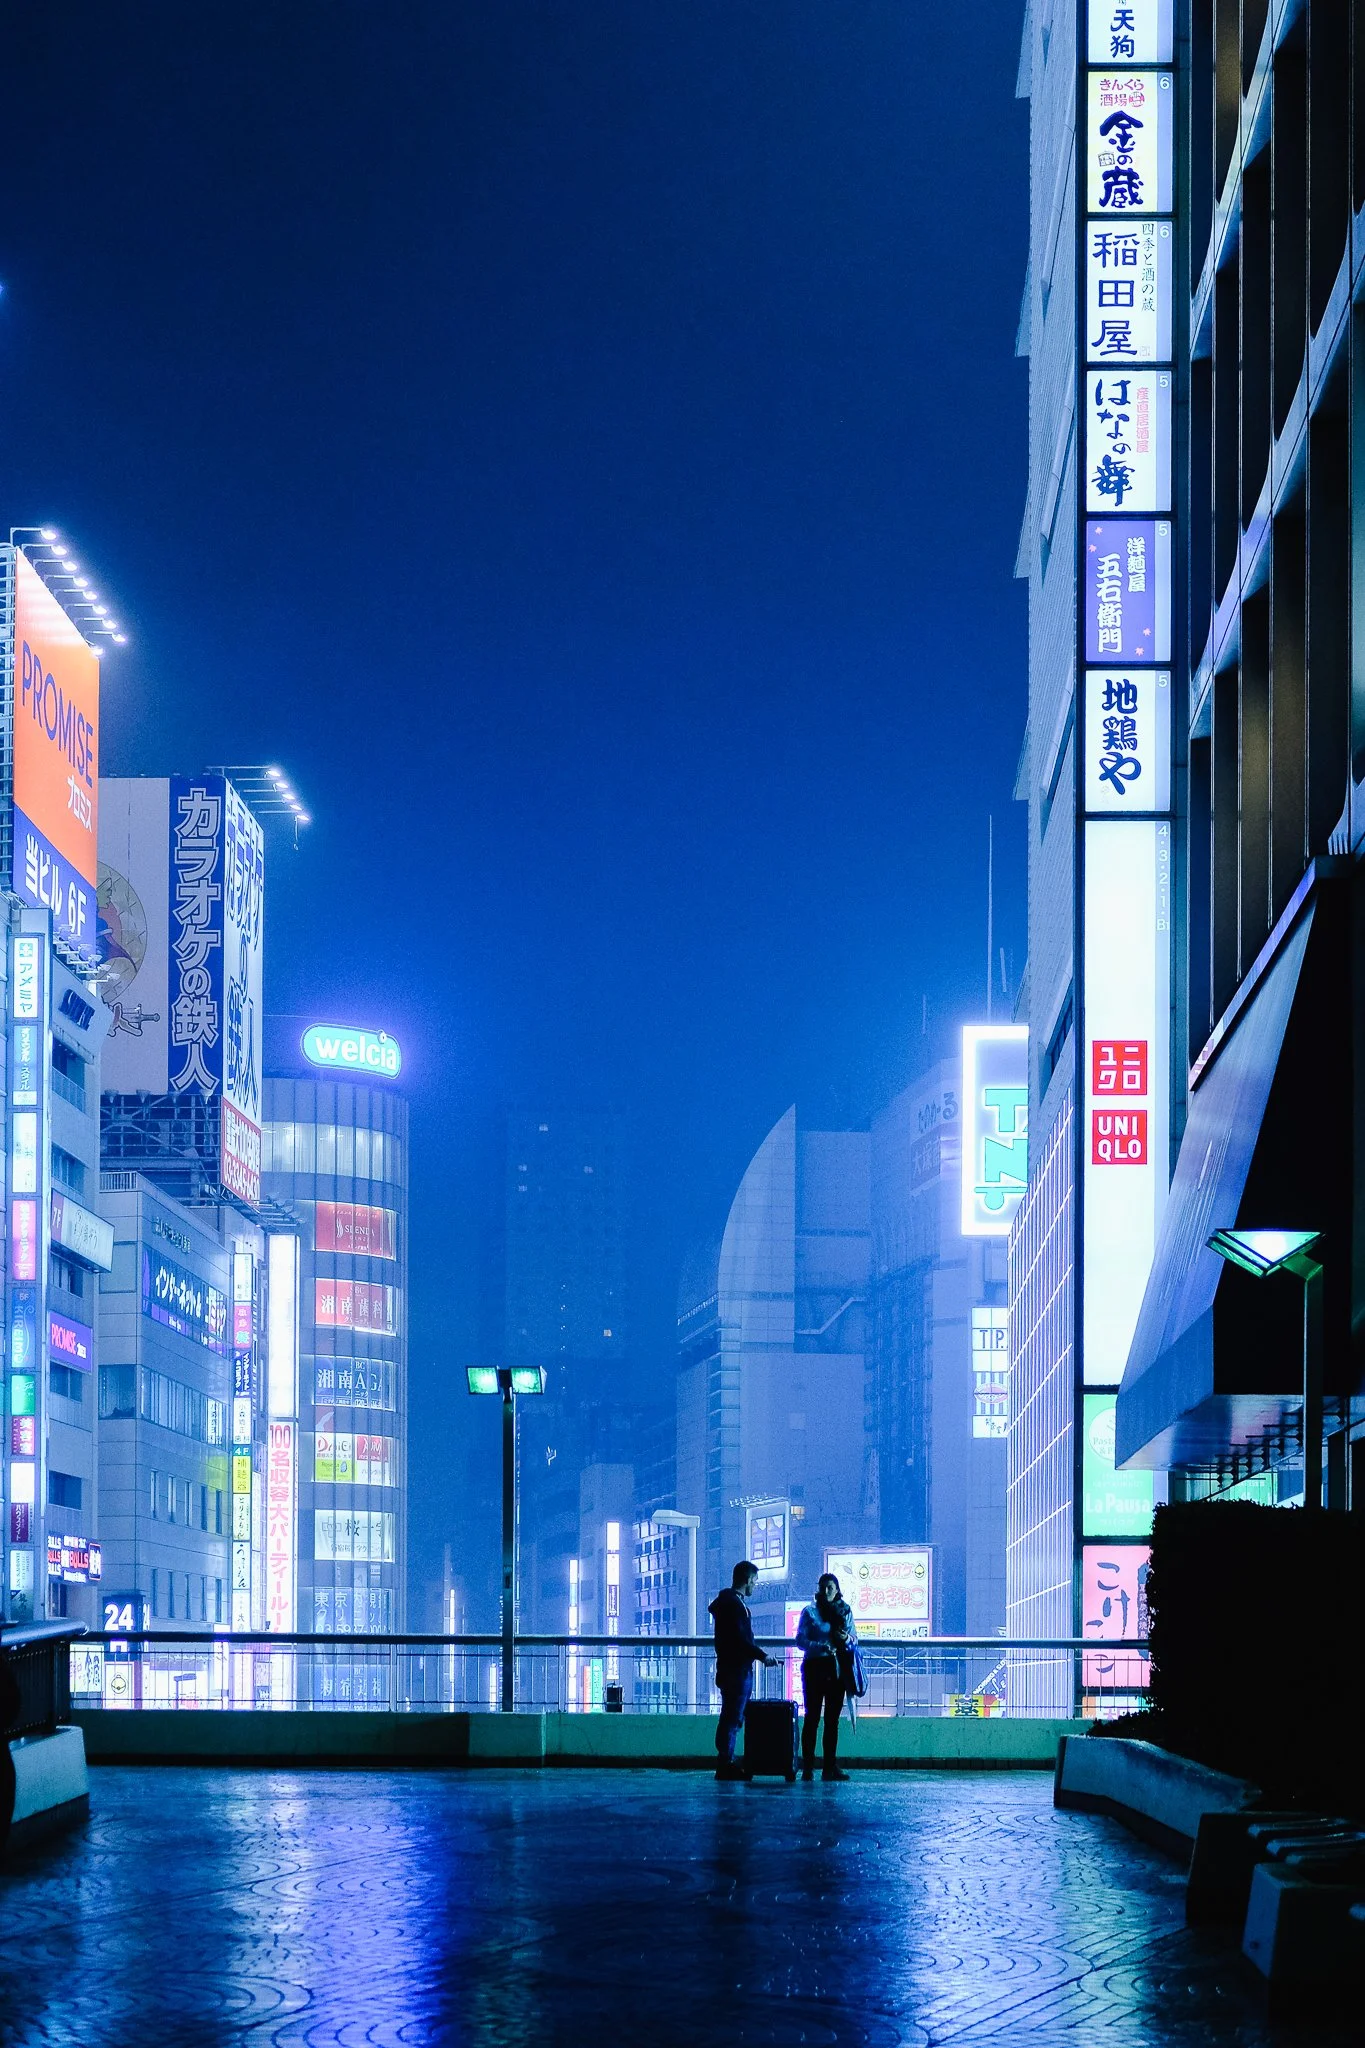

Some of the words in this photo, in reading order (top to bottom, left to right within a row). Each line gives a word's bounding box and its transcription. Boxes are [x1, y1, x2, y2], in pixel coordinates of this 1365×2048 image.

[1111, 9, 1134, 58] 天狗
[1099, 79, 1144, 92] きんくら
[1160, 77, 1170, 91] 6
[1100, 94, 1127, 107] 酒場
[1099, 110, 1144, 208] 金の蔵
[1159, 226, 1169, 241] 6
[1142, 222, 1155, 312] 四季と酒の蔵
[1091, 232, 1139, 356] 稲田屋
[1159, 375, 1168, 388] 5
[1091, 378, 1135, 506] はなの舞
[1158, 523, 1167, 538] 5
[1096, 553, 1123, 654] 五右衛門
[1158, 674, 1167, 688] 5
[22, 639, 93, 789] PROMISE
[1098, 679, 1141, 796] 地鶏や
[67, 774, 92, 833] プロミス
[25, 833, 63, 917] 当ビル
[67, 880, 87, 940] 6F
[172, 787, 222, 1095] カラオケの鉄人
[19, 962, 33, 1013] アメミヤ
[315, 1034, 397, 1071] welcia
[52, 1206, 61, 1230] 7F
[13, 1305, 24, 1364] KIREIMO
[51, 1323, 76, 1355] PROMISE
[234, 1446, 250, 1456] 4F
[1086, 1492, 1103, 1514] La
[1106, 1492, 1150, 1514] Pausa
[69, 1550, 89, 1569] BULLS
[870, 1562, 914, 1580] カラオケ
[858, 1585, 926, 1611] まねきねこ
[104, 1603, 134, 1631] 24
